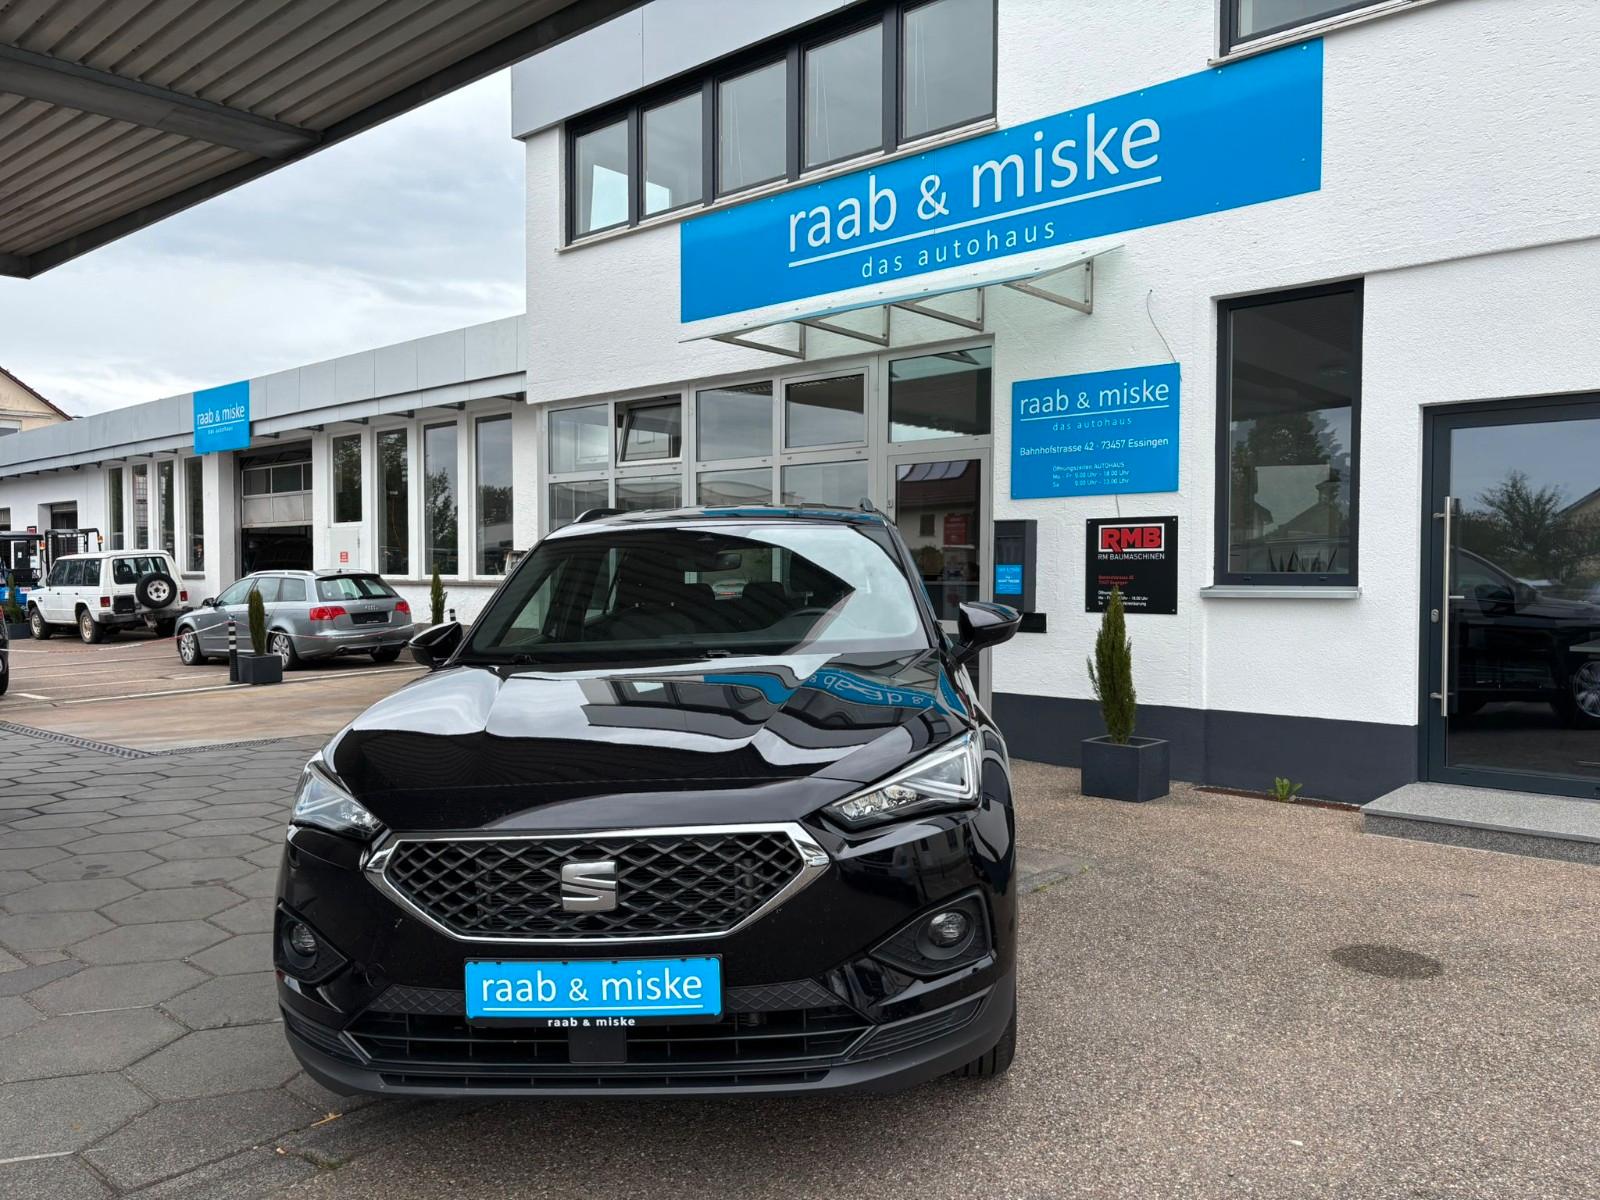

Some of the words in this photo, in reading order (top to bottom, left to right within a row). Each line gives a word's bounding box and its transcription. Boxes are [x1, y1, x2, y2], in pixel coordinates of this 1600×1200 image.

[789, 174, 897, 252] raab
[916, 174, 950, 220] &
[972, 112, 1161, 209] miske
[862, 256, 903, 278] das
[918, 222, 1056, 266] autohaus
[1020, 388, 1069, 415] raab
[1076, 391, 1091, 409] &
[1099, 378, 1170, 407] miske
[197, 408, 214, 425] raab
[222, 401, 245, 420] miske
[1052, 422, 1072, 431] das
[1076, 417, 1132, 430] autohaus
[1020, 445, 1082, 456] Bahnhofstrasse
[1084, 441, 1094, 451] 42
[1101, 439, 1126, 450] 73457
[1128, 437, 1169, 449] Essingen
[1102, 526, 1162, 553] RMB
[1110, 552, 1165, 560] BAUMASCHINEN
[482, 969, 557, 1002] raab
[568, 977, 590, 1002] &
[601, 967, 703, 1001] miske
[547, 1017, 578, 1027] raab
[582, 1018, 591, 1027] &
[596, 1016, 636, 1027] miske
